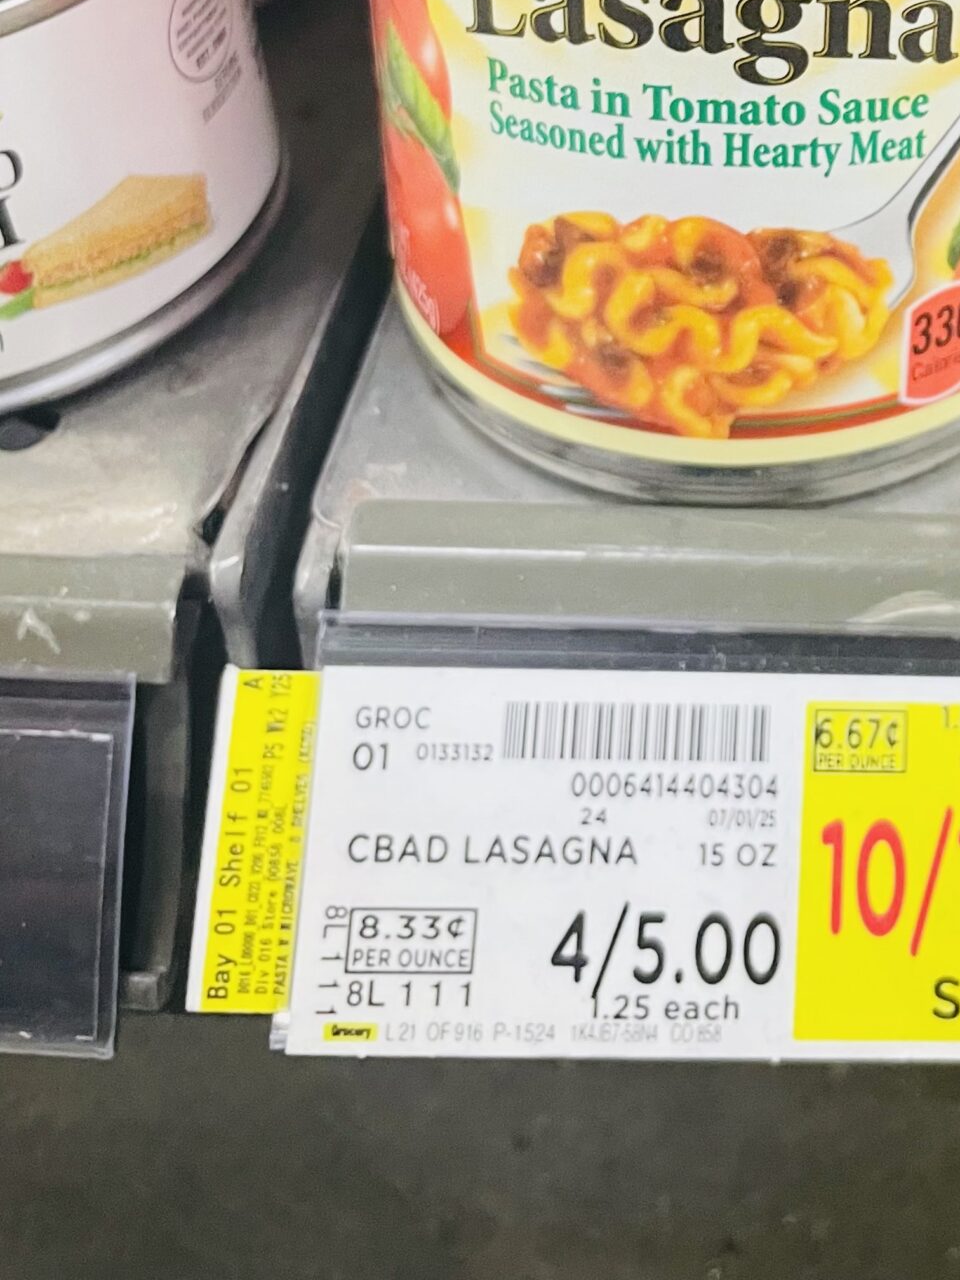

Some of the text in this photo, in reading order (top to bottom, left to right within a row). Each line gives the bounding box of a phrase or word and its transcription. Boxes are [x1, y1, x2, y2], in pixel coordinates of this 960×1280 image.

[486, 55, 929, 127] Pasta in Tomato Sauce
[489, 100, 927, 178] Seasoned with Hearty Meat
[355, 705, 433, 731] GROC
[815, 718, 899, 750] 6.67¢
[352, 741, 390, 771] 01
[415, 742, 495, 763] 0133132
[817, 753, 898, 770] PER OUNCE
[570, 771, 779, 799] 0006414404304
[580, 807, 608, 825] 24
[207, 676, 264, 999] Bay 01 Shelf 01 A
[347, 833, 639, 866] CBAD LASAGNA
[699, 842, 778, 868] 15 OZ
[359, 914, 466, 940] 8.33¢
[351, 948, 470, 968] PER OUNCE
[550, 900, 782, 1000] 4/5.00
[272, 955, 289, 996] PASTA
[346, 980, 385, 1007] 8L
[591, 993, 741, 1021] 1.25 each
